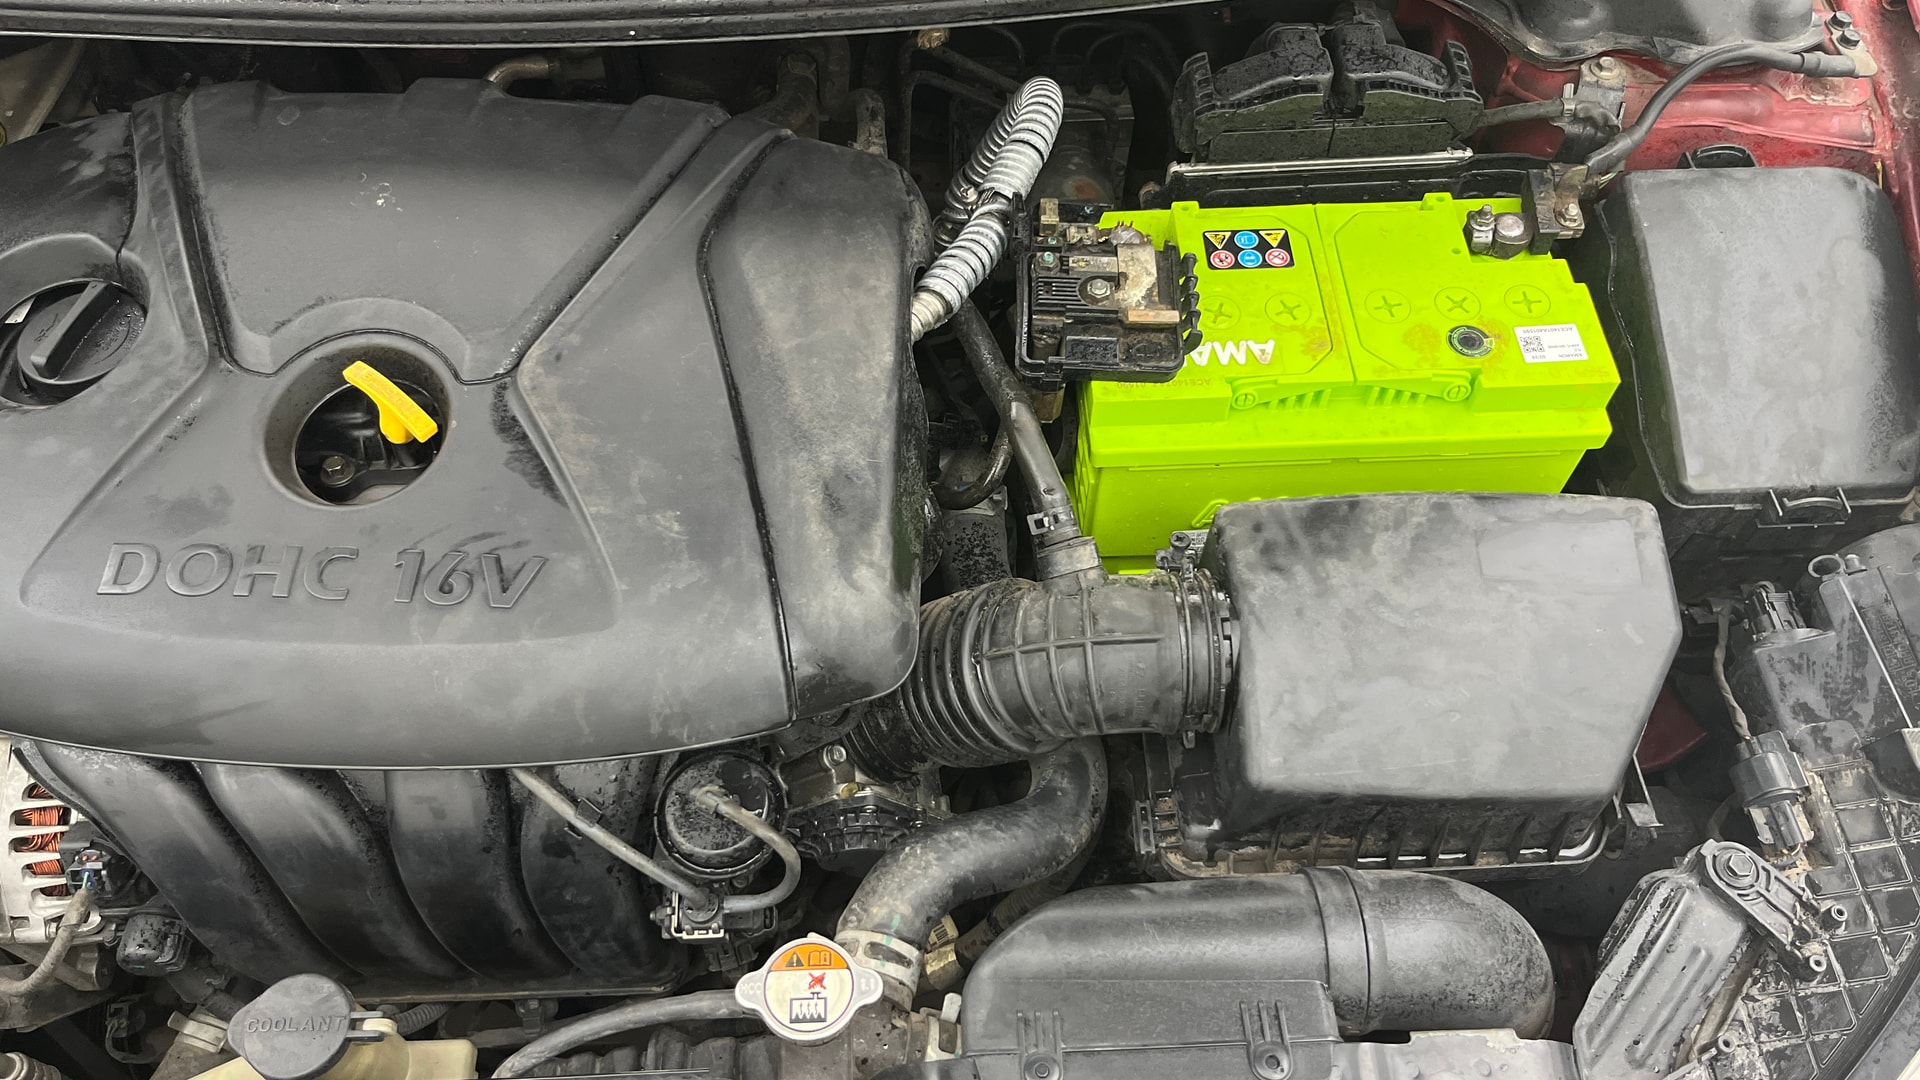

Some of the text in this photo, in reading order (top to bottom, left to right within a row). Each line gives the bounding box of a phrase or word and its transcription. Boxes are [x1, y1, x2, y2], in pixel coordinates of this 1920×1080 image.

[1182, 339, 1276, 367] AMA
[96, 542, 549, 608] DOHC 16V
[245, 1014, 347, 1034] COOLANT
